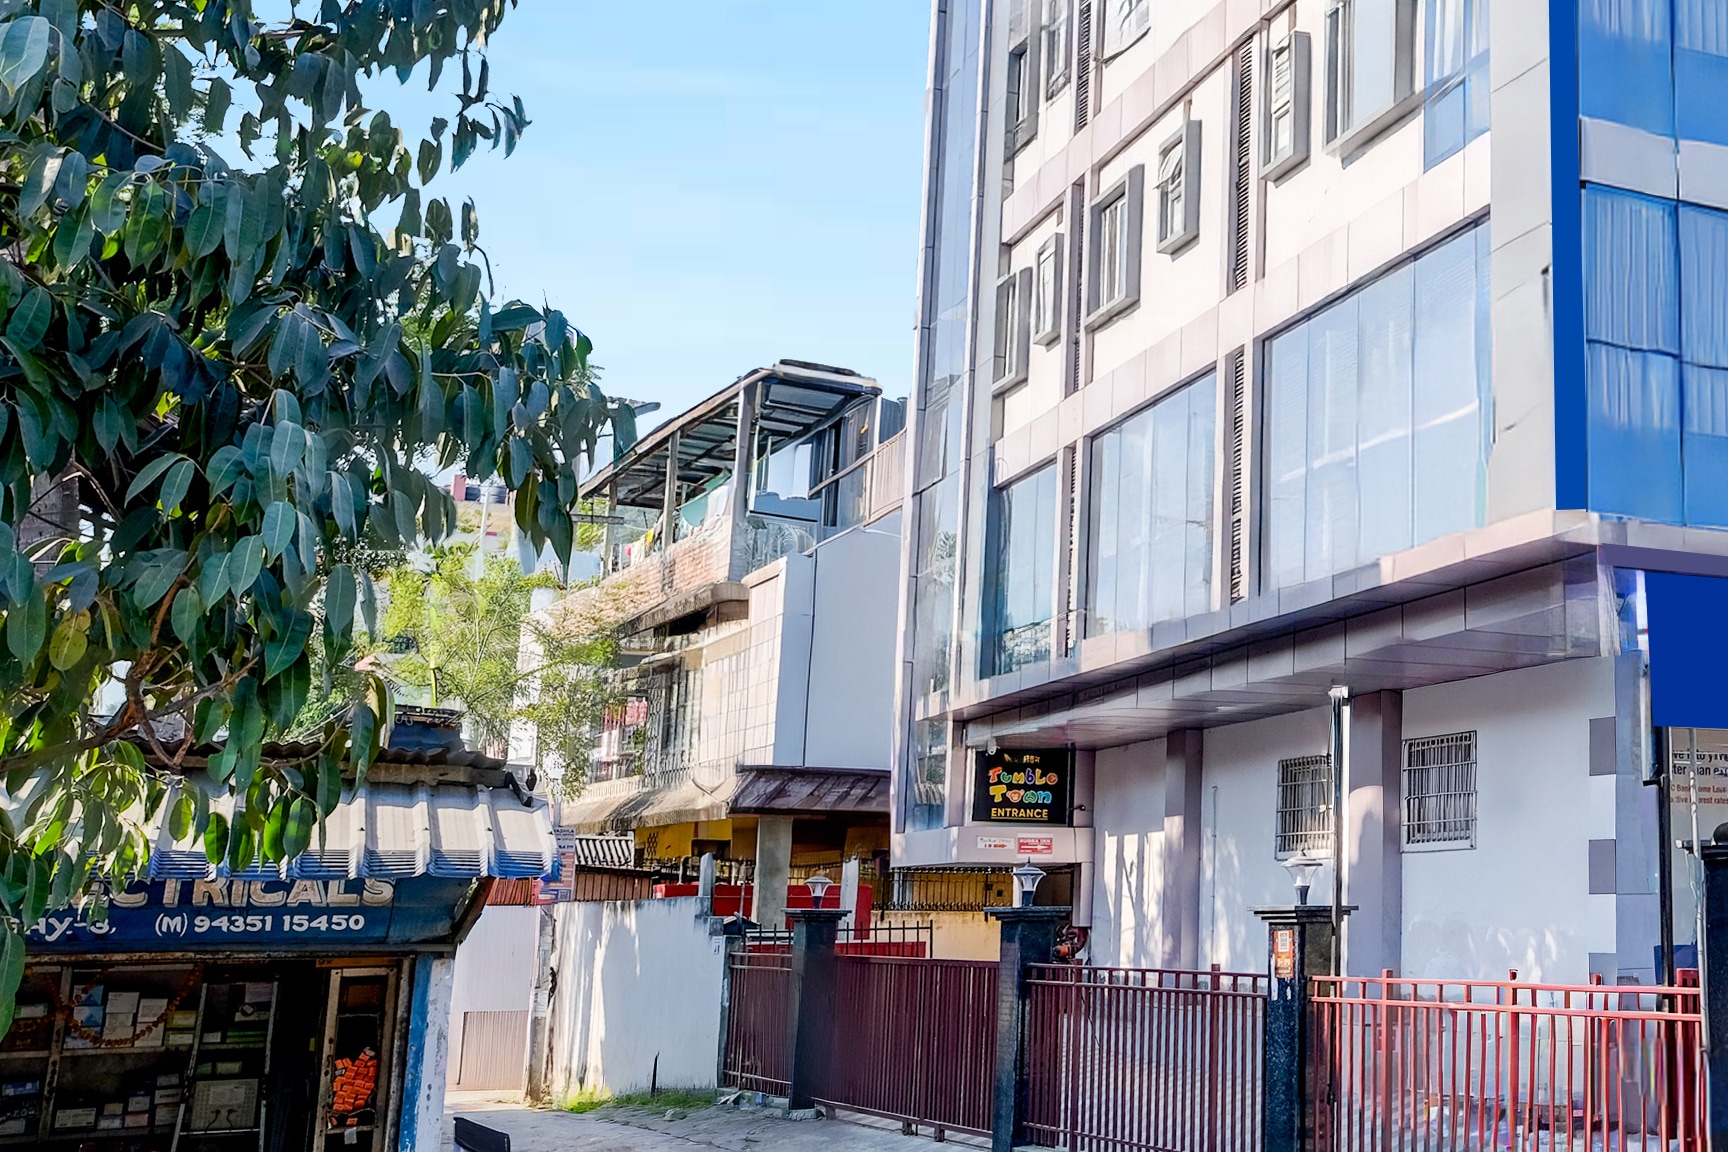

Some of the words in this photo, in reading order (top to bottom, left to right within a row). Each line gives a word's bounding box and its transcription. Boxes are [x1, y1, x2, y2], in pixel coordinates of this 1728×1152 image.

[991, 808, 1049, 819] ENTRANCE
[155, 913, 188, 937] (M)
[194, 915, 273, 932] 94351
[283, 914, 366, 931] 15450
